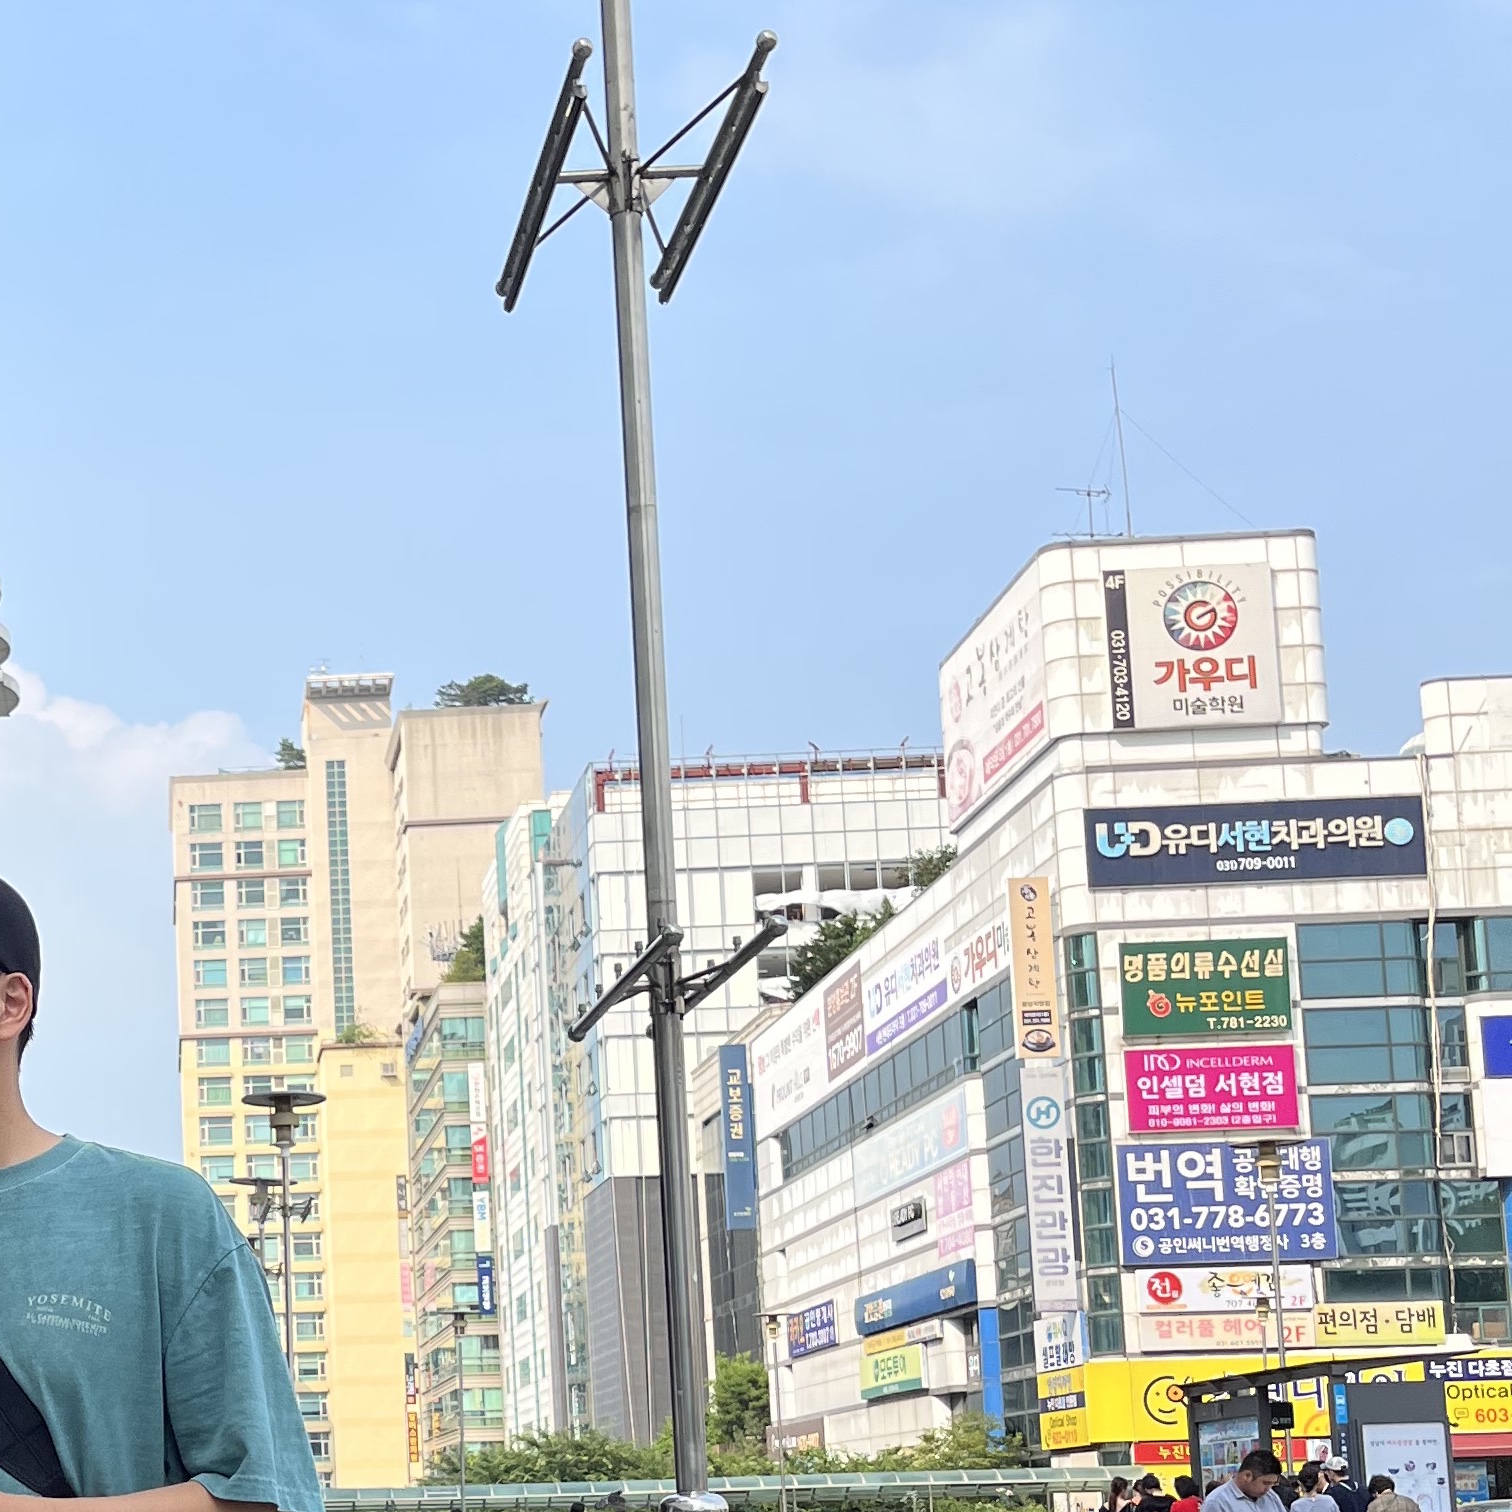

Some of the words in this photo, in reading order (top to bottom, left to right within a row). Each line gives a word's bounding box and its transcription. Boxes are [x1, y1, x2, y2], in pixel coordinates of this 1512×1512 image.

[1105, 575, 1125, 590] 4F
[1153, 569, 1247, 607] POSSIBILITY
[1153, 655, 1258, 693] 가우디
[1173, 695, 1245, 716] 미술학원
[964, 925, 998, 984] 가우디
[1123, 948, 1284, 983] 명품의류수선실
[1176, 989, 1266, 1013] 뉴포인트
[1206, 1015, 1288, 1030] T.781-2230
[1186, 1056, 1274, 1069] INCELLDERM
[1137, 1074, 1207, 1099] 인셀덤
[1215, 1071, 1285, 1097] 서현점
[727, 1069, 744, 1140] 교보증권
[1148, 1104, 1184, 1116] 피부의
[1232, 1145, 1322, 1173] 공대행
[1126, 1148, 1224, 1203] 번역
[1029, 1137, 1071, 1277] 한진관광
[1130, 1202, 1325, 1231] 031-778-6773
[1300, 1232, 1327, 1250] 3층
[1150, 1277, 1172, 1299] 전
[1291, 1295, 1306, 1307] 2F
[27, 1293, 112, 1322] YOSEMITE
[1317, 1306, 1378, 1335] 편의점
[1395, 1306, 1437, 1334] 담배
[1155, 1318, 1215, 1339] 컬러풀
[1223, 1318, 1263, 1336] 헤어
[1284, 1325, 1306, 1344] 2F
[880, 1354, 907, 1381] 모두투어
[1429, 1361, 1464, 1378] 누진
